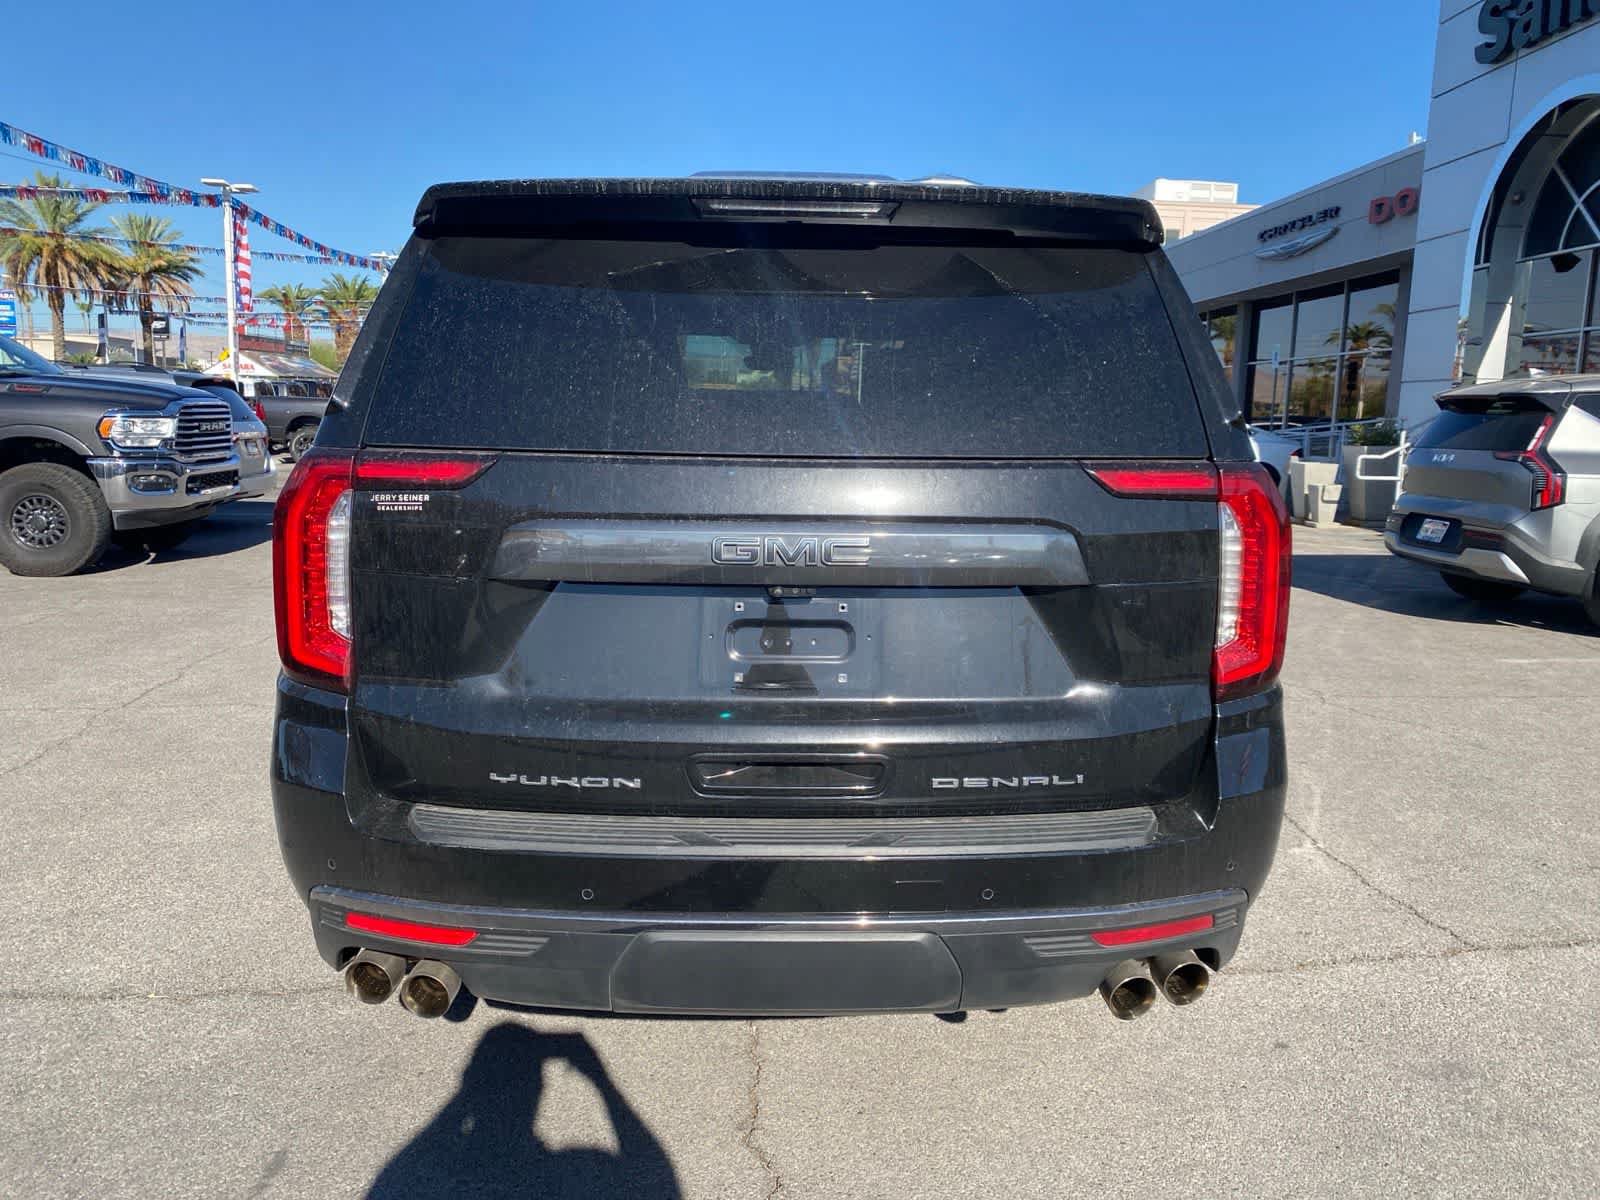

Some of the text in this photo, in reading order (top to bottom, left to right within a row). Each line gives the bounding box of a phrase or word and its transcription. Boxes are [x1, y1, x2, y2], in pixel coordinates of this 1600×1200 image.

[370, 494, 430, 502] JERRY SEINER
[711, 536, 871, 567] GMC
[488, 771, 641, 789] YUKON
[931, 773, 1085, 789] DENALI
